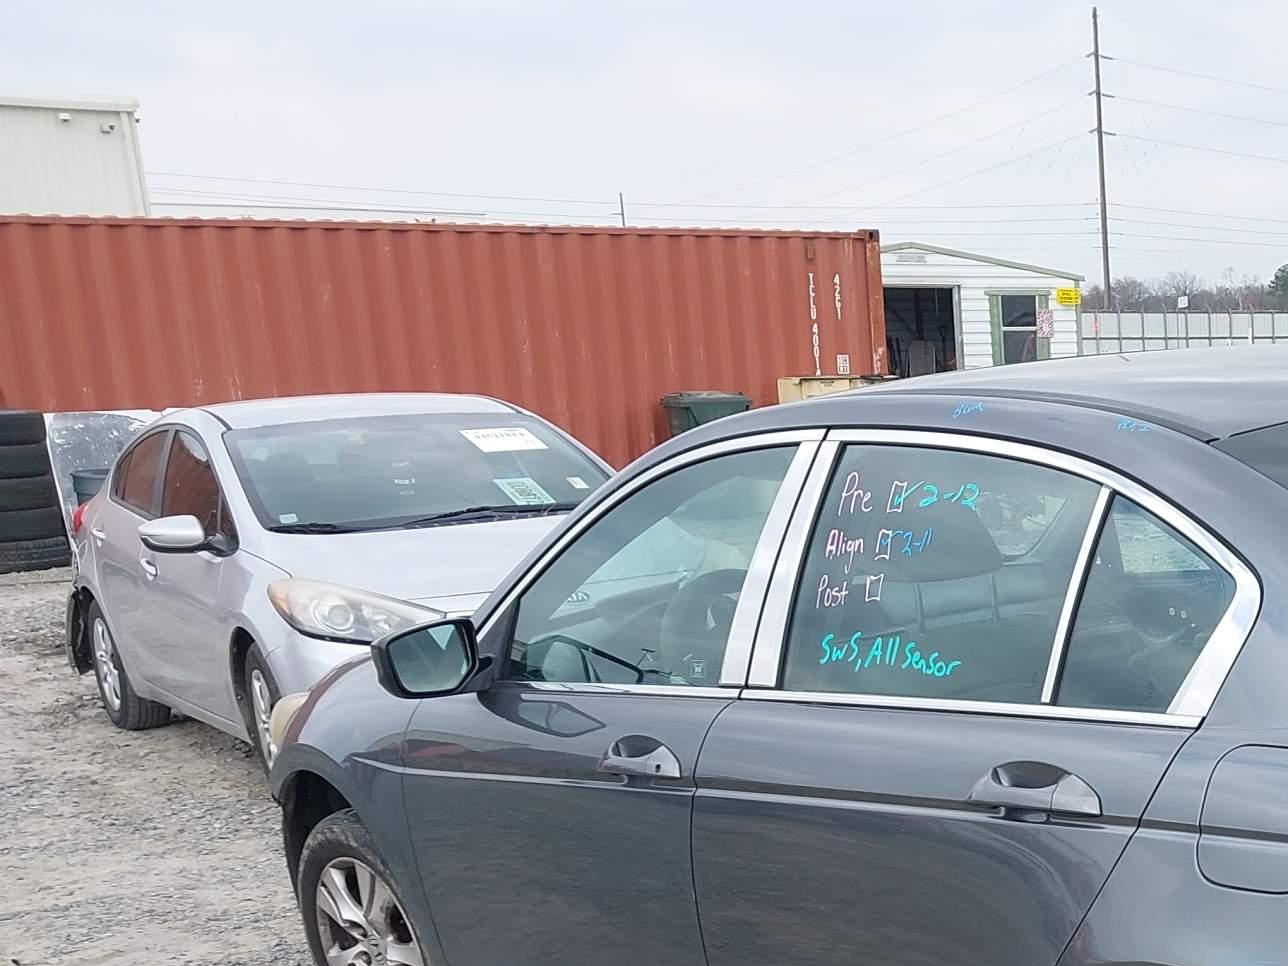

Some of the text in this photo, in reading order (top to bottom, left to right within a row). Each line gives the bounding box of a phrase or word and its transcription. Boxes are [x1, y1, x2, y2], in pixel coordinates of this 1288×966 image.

[838, 472, 873, 516] Pre
[826, 529, 864, 574] Align
[816, 574, 849, 609] Post
[864, 635, 901, 671] All
